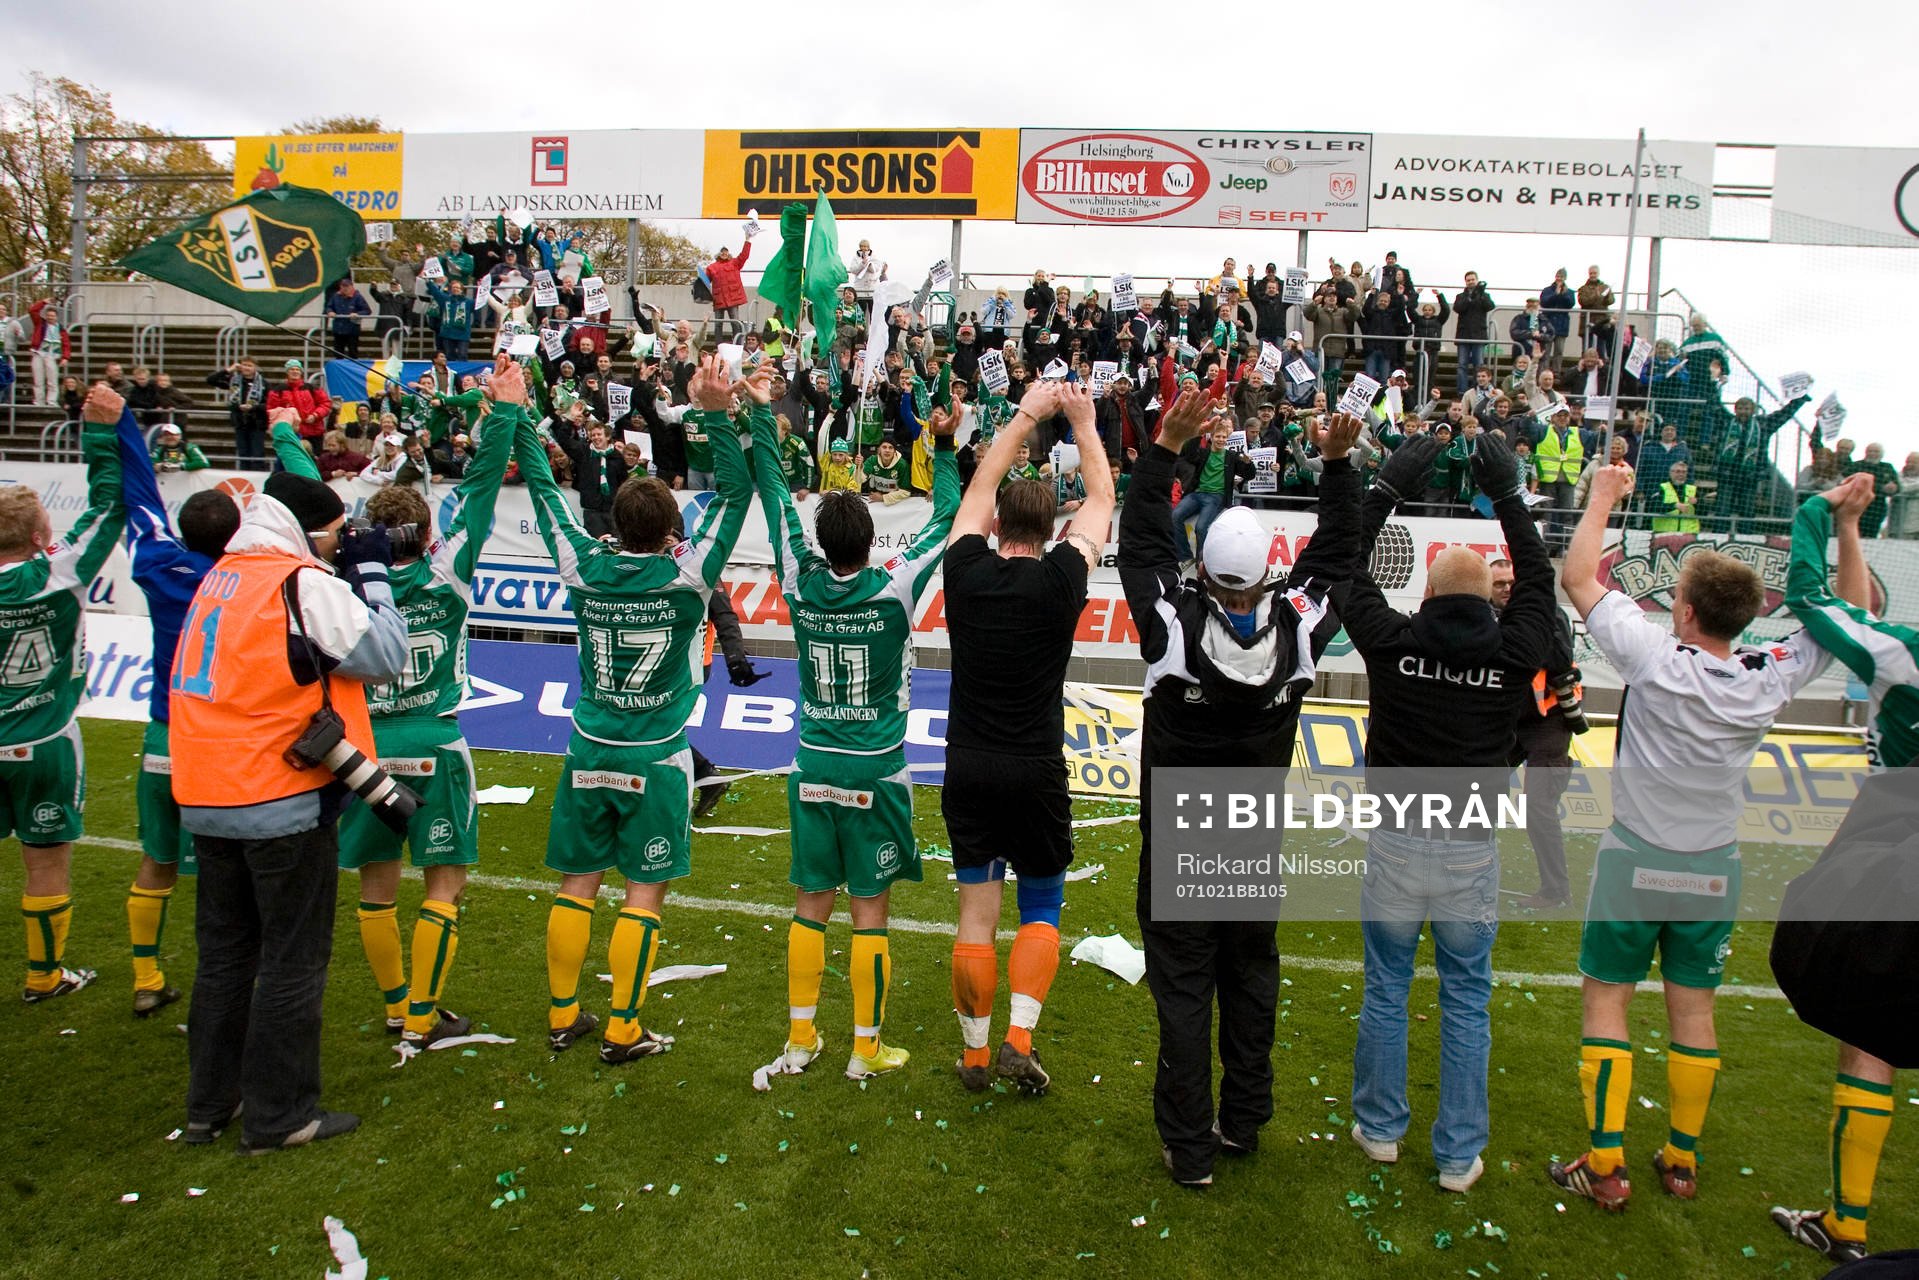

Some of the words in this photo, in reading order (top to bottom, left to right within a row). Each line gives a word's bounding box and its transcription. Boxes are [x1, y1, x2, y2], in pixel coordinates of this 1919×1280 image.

[1080, 142, 1154, 160] Helsingborg
[1197, 138, 1366, 151] CHRYSLER
[743, 153, 937, 194] OHLSSONS
[1394, 156, 1682, 179] ADVOKATAKTIEBOLAGET
[1035, 160, 1149, 196] Bilhuset
[1166, 172, 1191, 188] No.1
[1220, 173, 1267, 193] Jeep
[436, 194, 464, 212] AB
[469, 193, 664, 212] LANDSKRONAHEM
[1515, 187, 1536, 205] &
[1249, 210, 1329, 222] SEAT
[271, 236, 312, 269] 1926
[1114, 282, 1132, 293] LSK
[1285, 278, 1304, 287] LSK
[981, 354, 1002, 371] LSK
[1094, 371, 1115, 381] LSK
[610, 395, 629, 405] LSK
[1350, 385, 1372, 403] LSK
[1256, 461, 1274, 471] SK
[584, 598, 671, 613] Stenungsunds
[430, 610, 448, 622] AB
[611, 613, 623, 623] &
[658, 609, 677, 621] AB
[824, 622, 835, 632] &
[867, 620, 886, 632] AB
[1, 624, 61, 688] 4
[587, 625, 673, 693] 17
[808, 639, 870, 706] 11
[1398, 655, 1505, 689] CLIQUE
[576, 773, 629, 788] Swedbank
[802, 785, 855, 804] Swedbank
[38, 807, 59, 821] BE
[432, 823, 450, 841] BE
[648, 840, 667, 859] BE
[880, 848, 896, 865] BE
[1637, 873, 1706, 891] Swedbank
